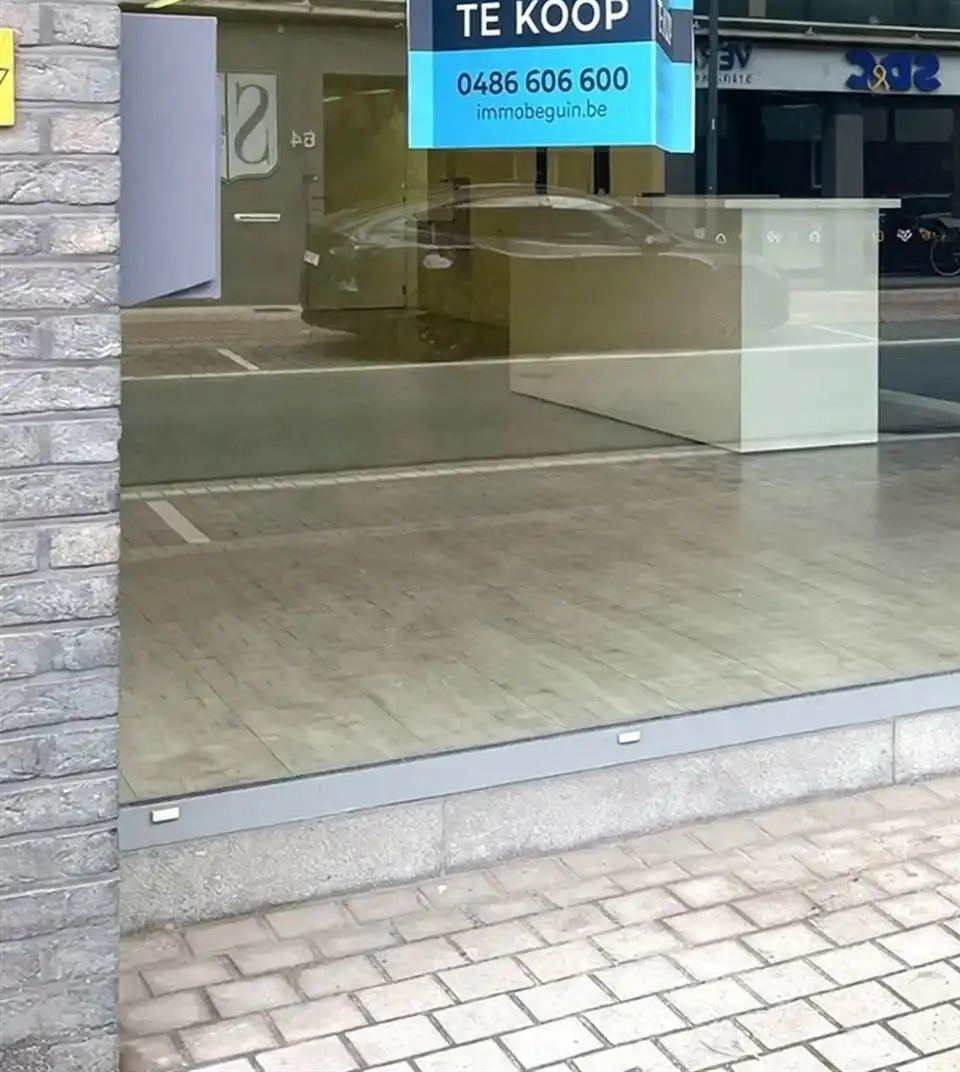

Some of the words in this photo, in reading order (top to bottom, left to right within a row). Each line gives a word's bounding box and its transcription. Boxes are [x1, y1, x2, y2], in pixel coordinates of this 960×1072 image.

[456, 2, 501, 37] TE
[457, 71, 518, 96] 0486
[526, 69, 572, 93] 606
[580, 66, 629, 92] 600
[477, 99, 607, 123] immobeguin.be
